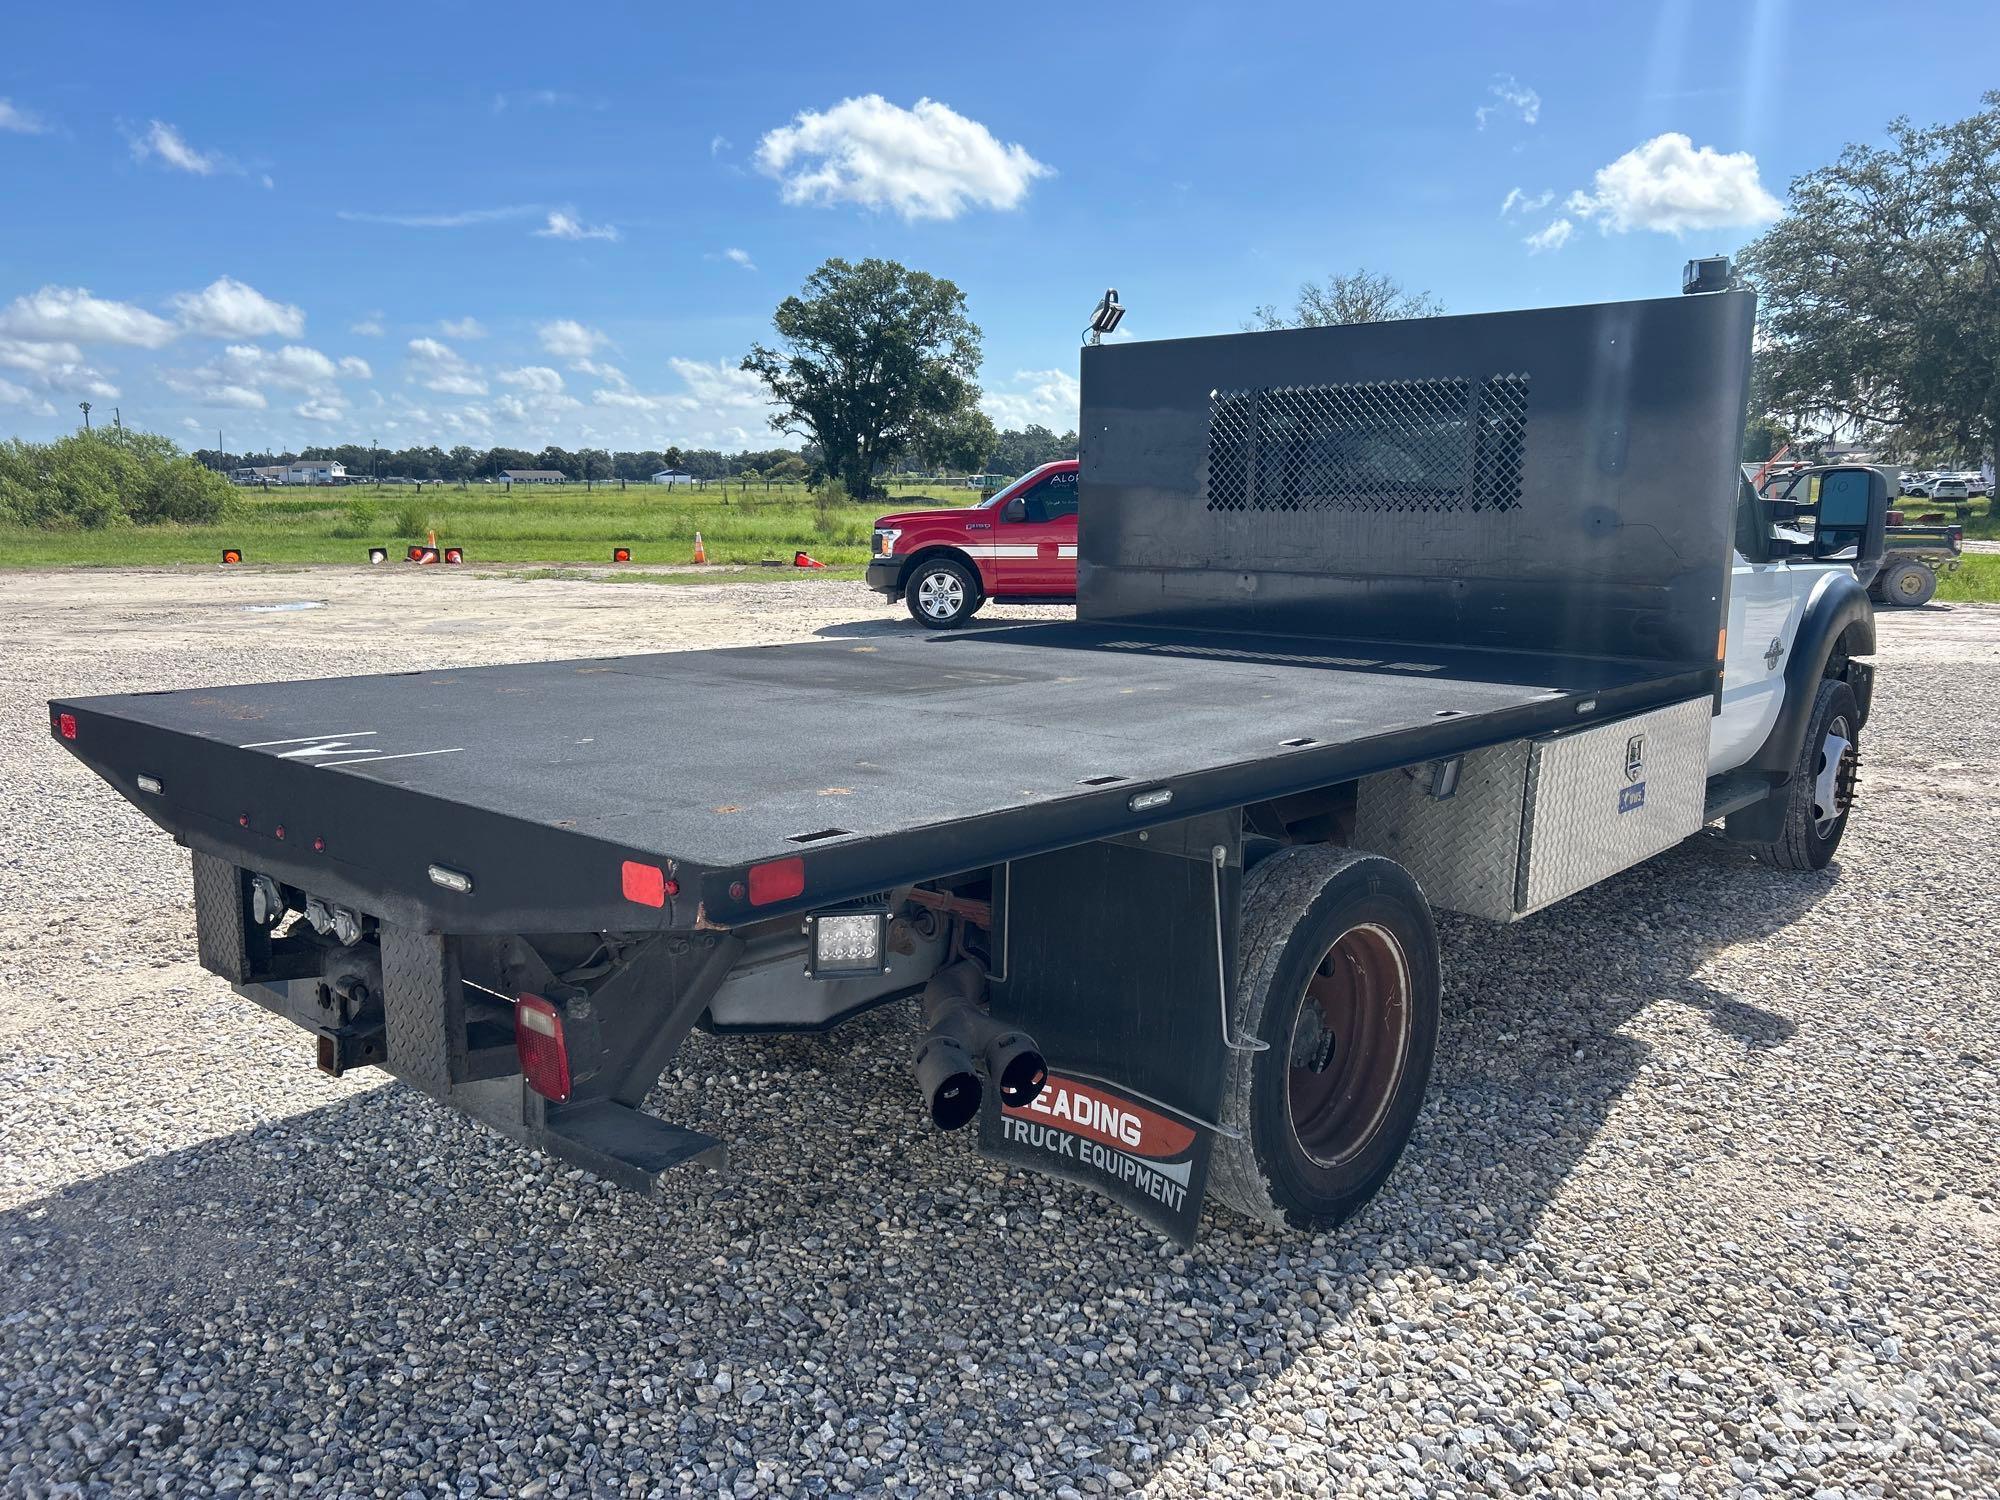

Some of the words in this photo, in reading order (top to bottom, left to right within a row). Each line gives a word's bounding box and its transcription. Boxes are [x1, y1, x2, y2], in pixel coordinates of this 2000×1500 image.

[1014, 1084, 1142, 1147] EADING
[1001, 1117, 1075, 1157] TRUCK
[1079, 1139, 1187, 1213] EQUIPMENT
